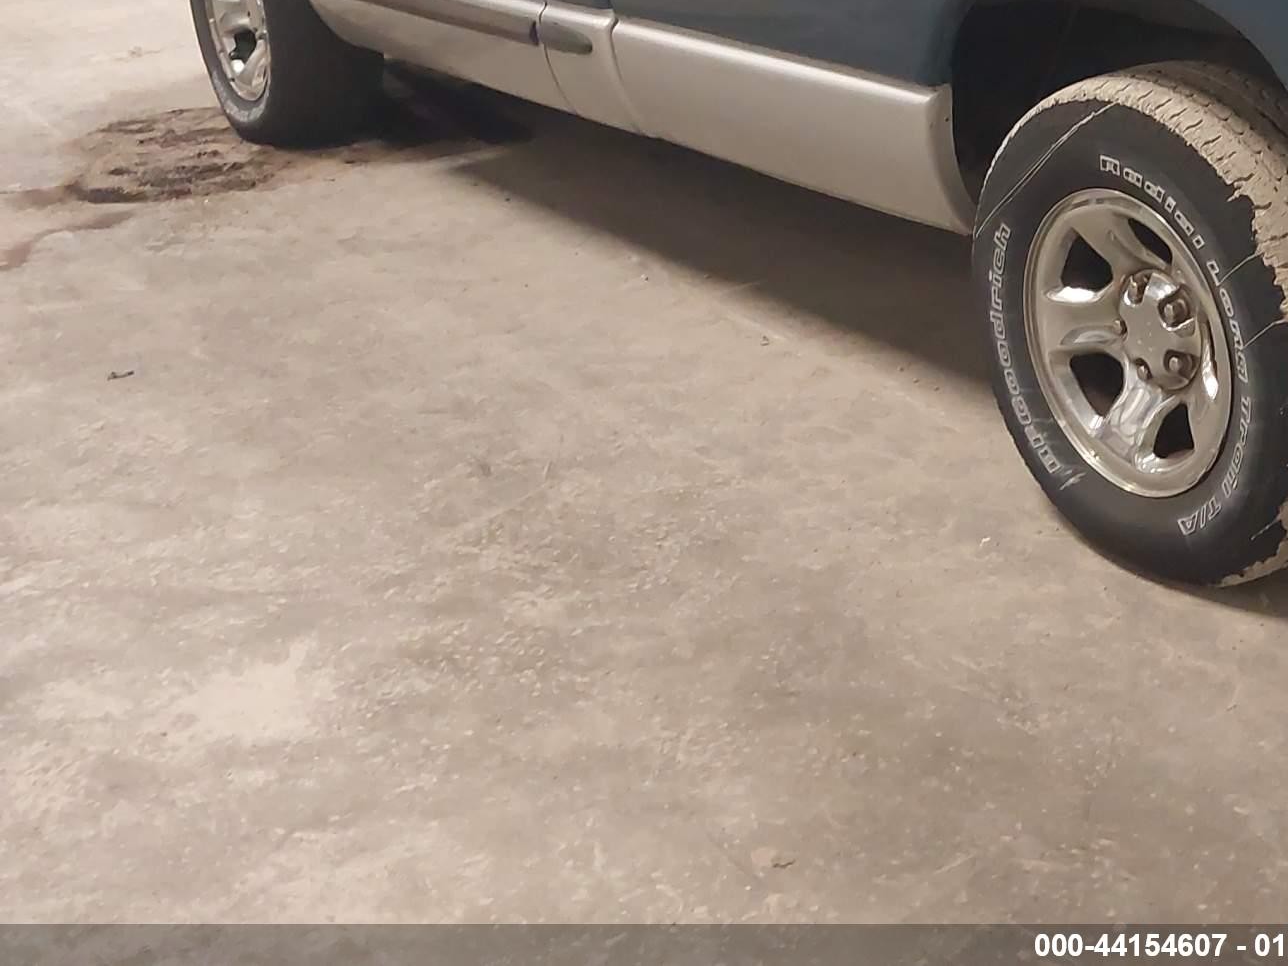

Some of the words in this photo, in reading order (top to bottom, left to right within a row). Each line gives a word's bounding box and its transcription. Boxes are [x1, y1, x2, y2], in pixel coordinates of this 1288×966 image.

[1100, 154, 1205, 249] Radial
[1206, 260, 1249, 383] Long
[1221, 395, 1252, 499] Trail
[1177, 496, 1222, 536] T/A
